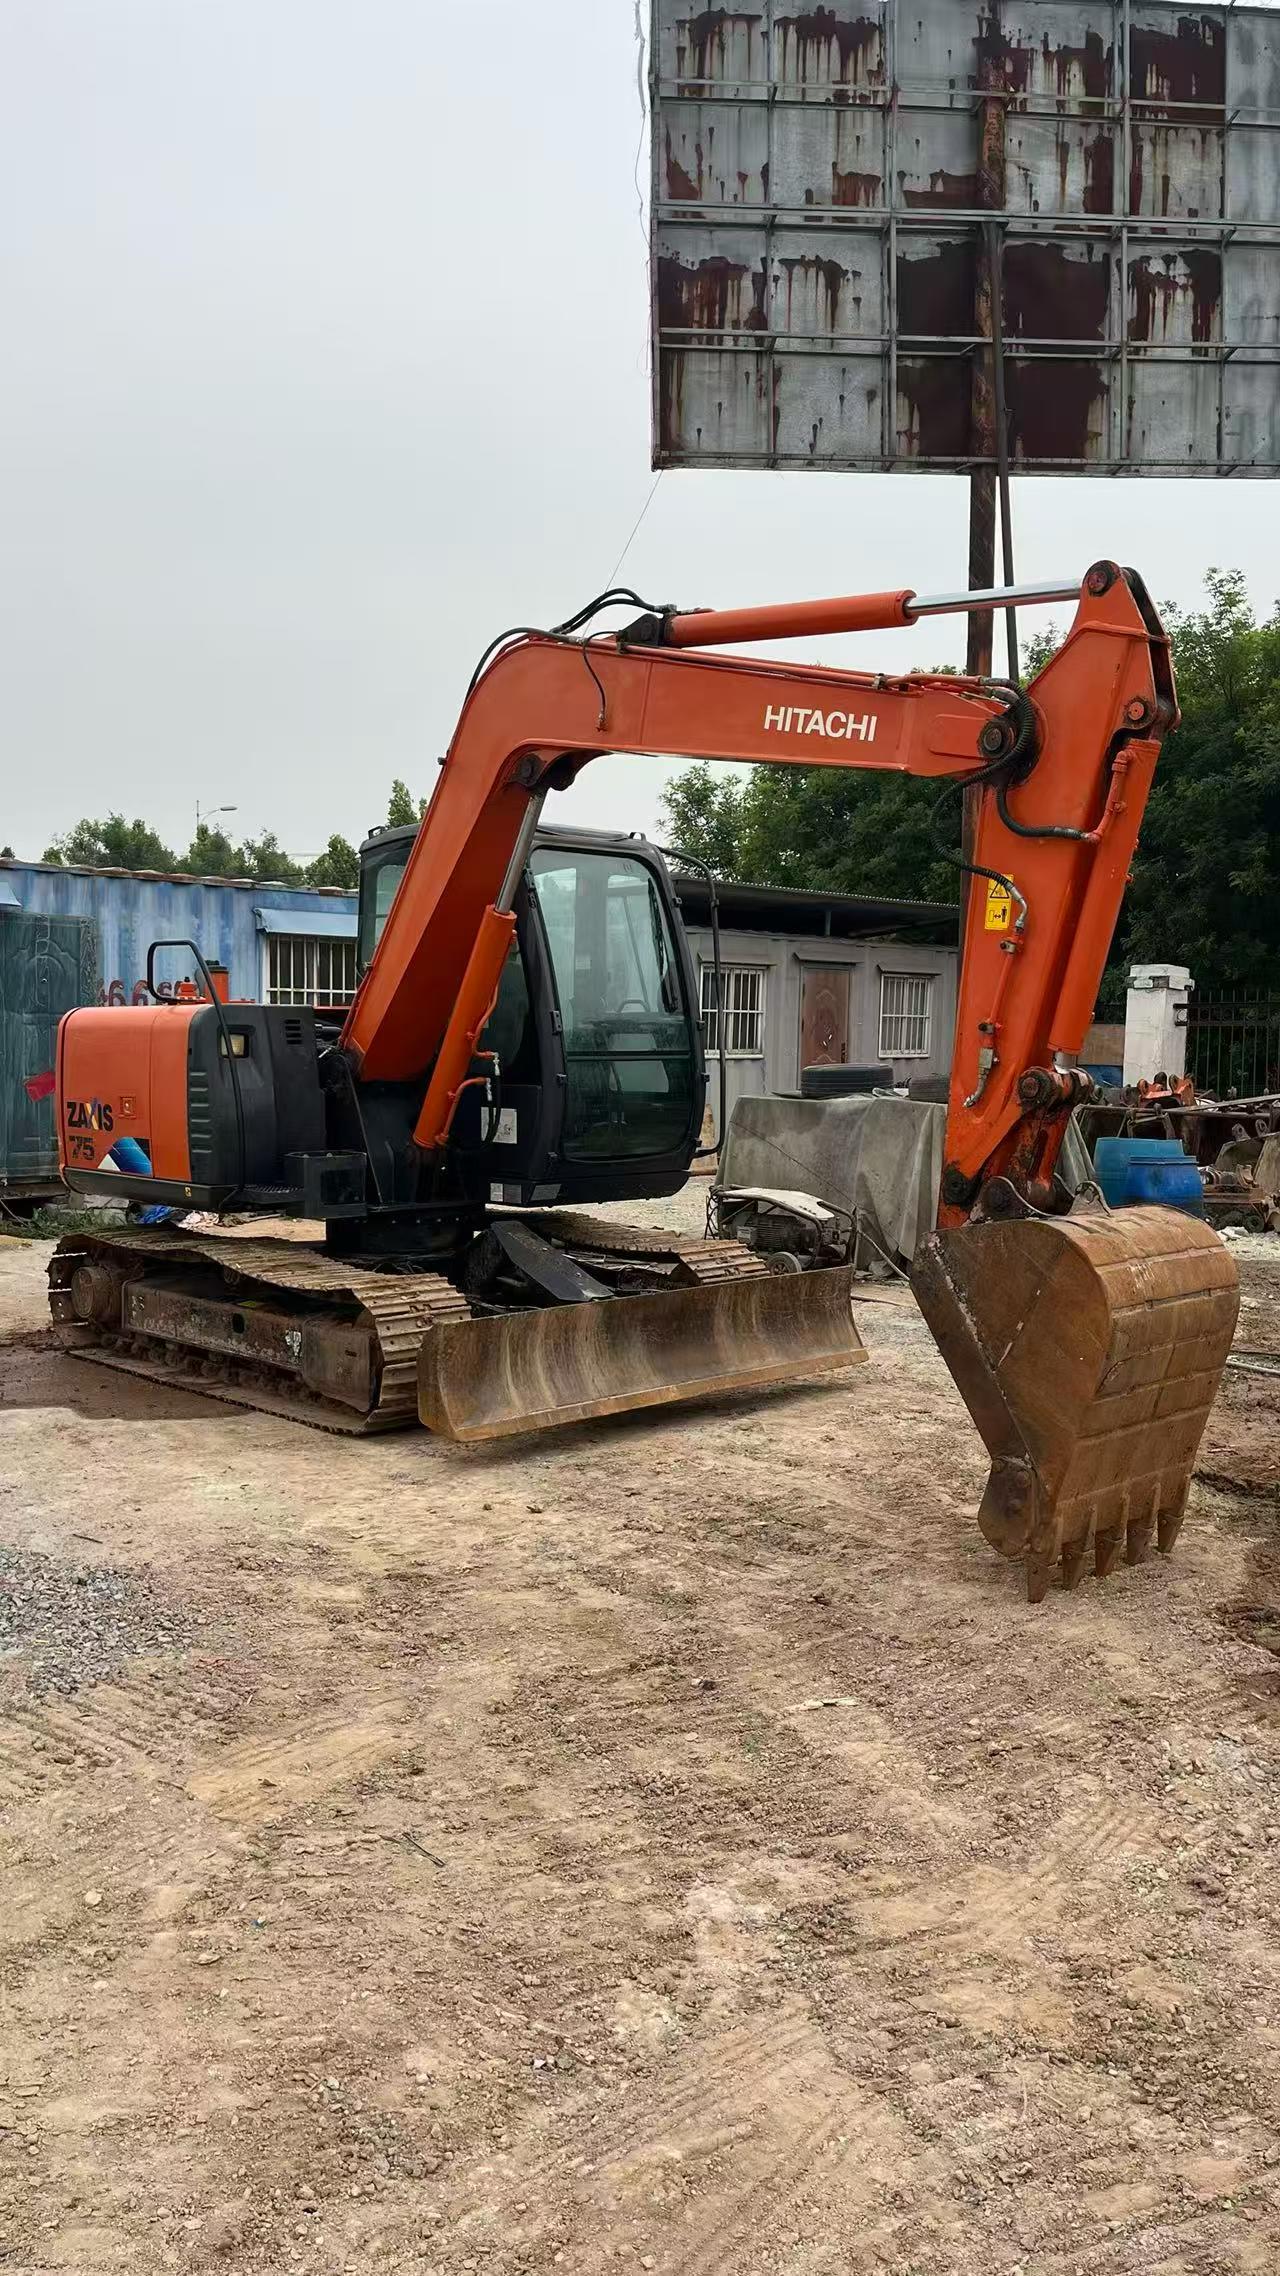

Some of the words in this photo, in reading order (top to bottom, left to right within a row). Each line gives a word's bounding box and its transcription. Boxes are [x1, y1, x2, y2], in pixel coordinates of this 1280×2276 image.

[763, 705, 878, 742] HITACHI
[66, 1098, 114, 1132] ZAXIS
[68, 1135, 96, 1160] 75
